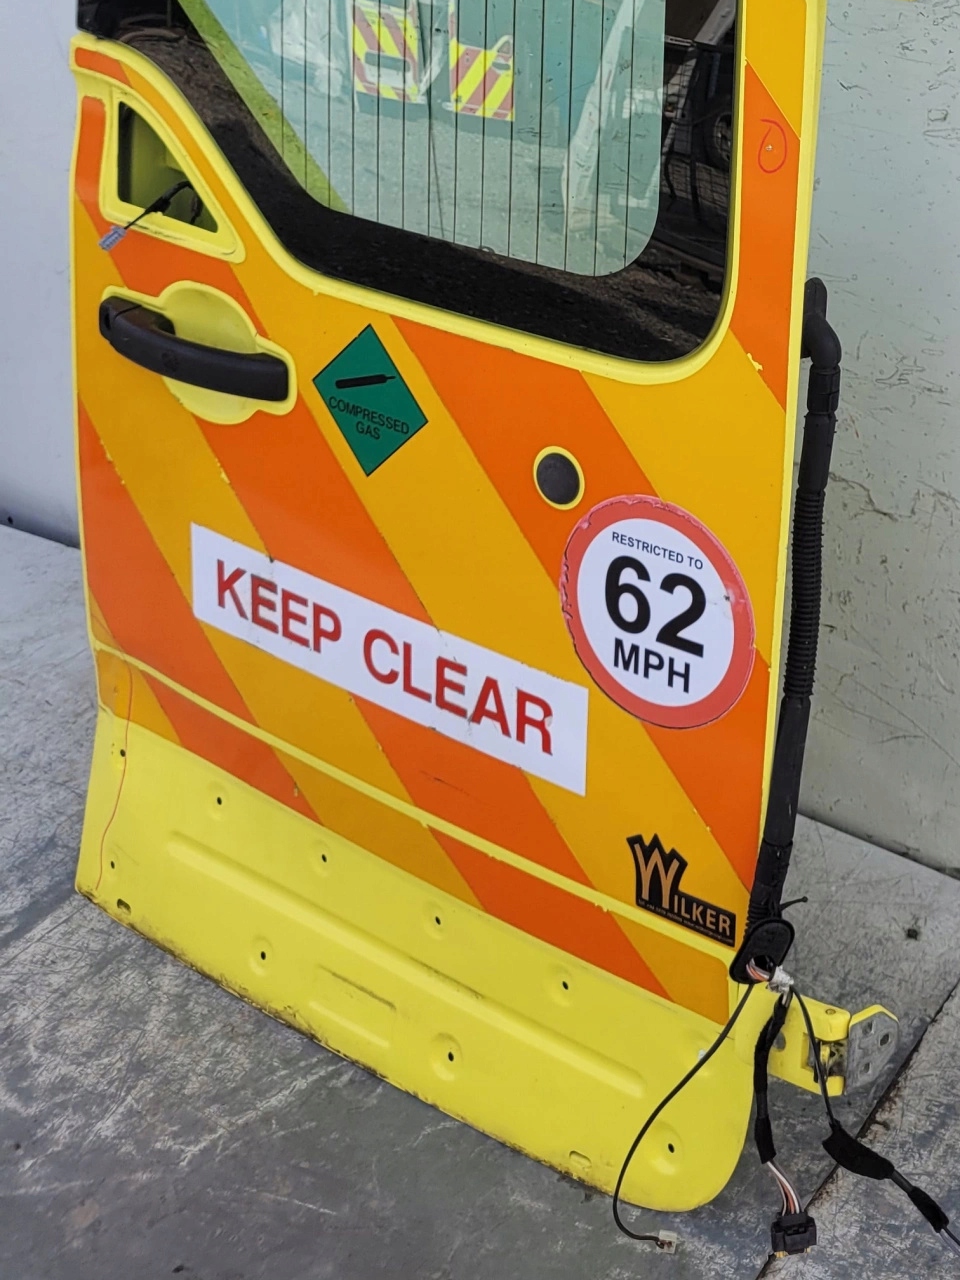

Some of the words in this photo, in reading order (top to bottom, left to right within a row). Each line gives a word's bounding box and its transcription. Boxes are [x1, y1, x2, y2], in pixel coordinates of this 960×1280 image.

[329, 396, 409, 434] COMPRESSED
[356, 421, 380, 440] GAS
[612, 531, 684, 564] RESTRICTED
[687, 556, 703, 570] TO
[605, 555, 706, 658] 62
[216, 558, 342, 654] KEEP
[363, 629, 553, 756] CLEAR
[613, 637, 691, 693] MPH
[633, 843, 731, 936] WILKER
